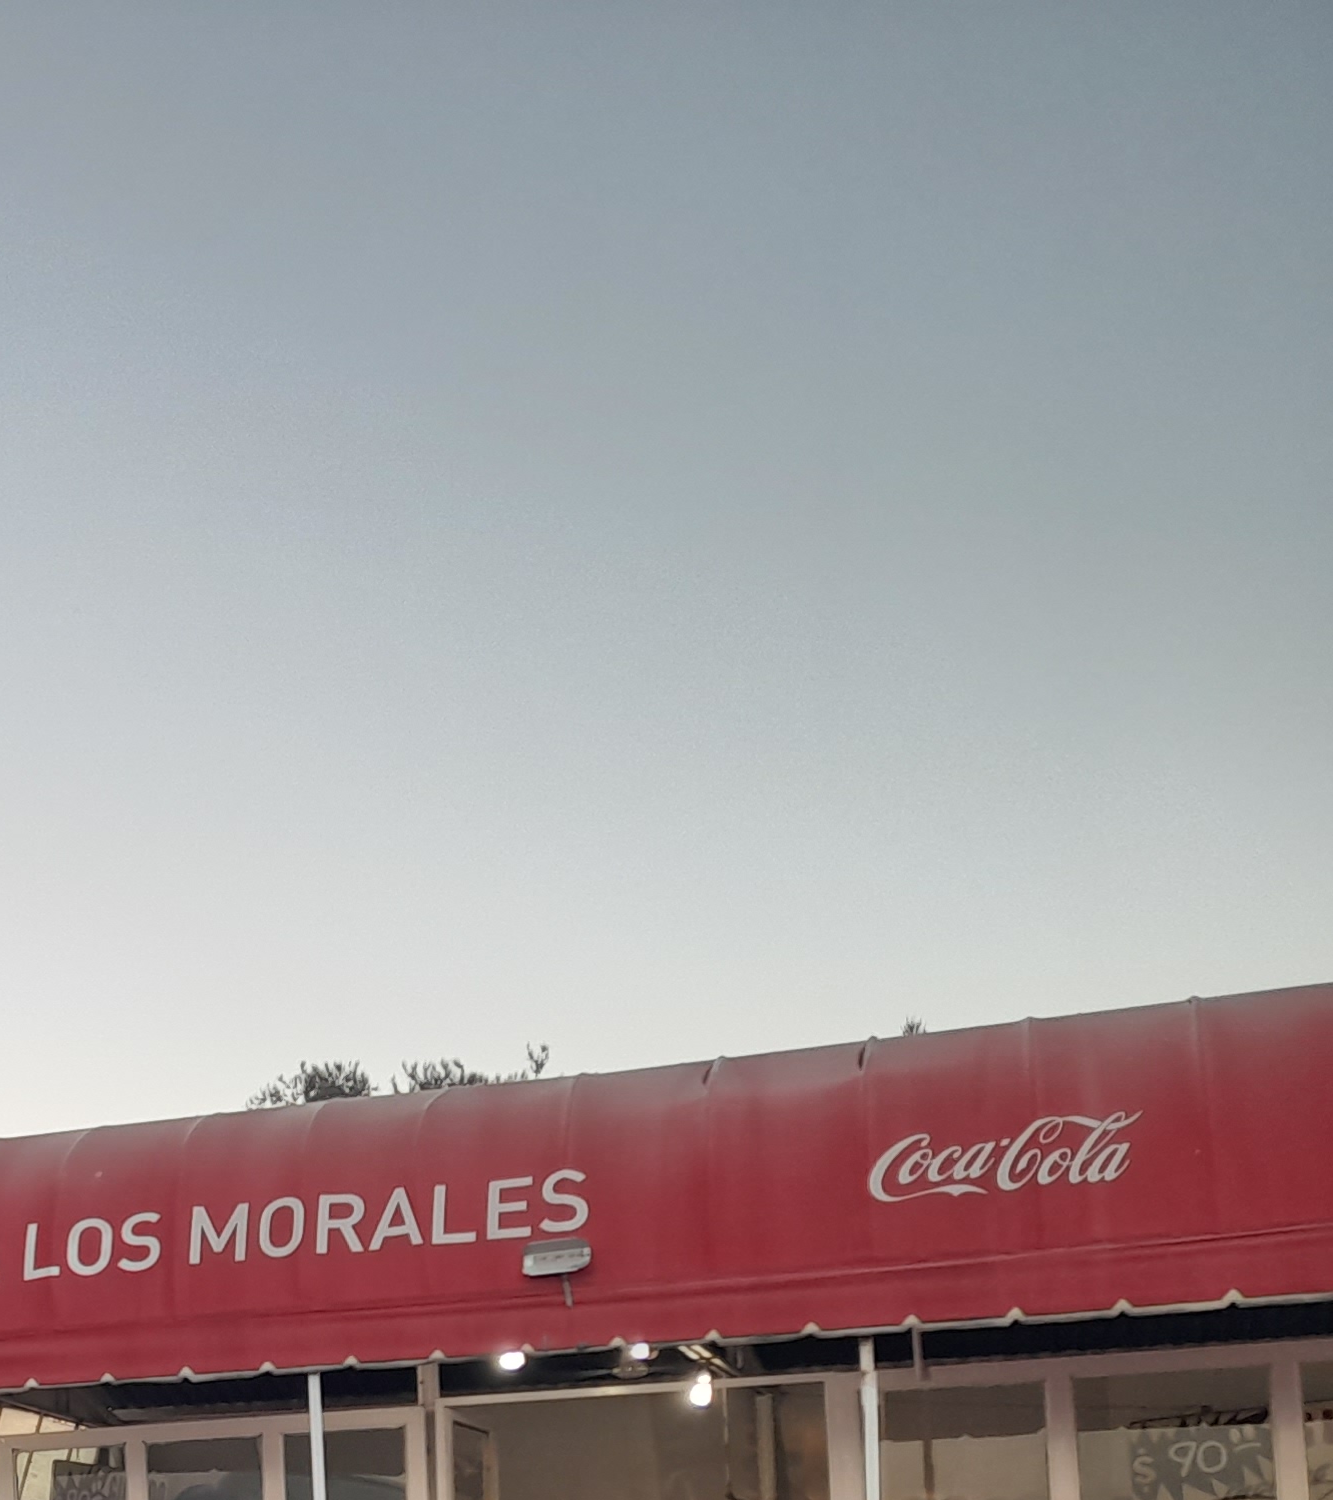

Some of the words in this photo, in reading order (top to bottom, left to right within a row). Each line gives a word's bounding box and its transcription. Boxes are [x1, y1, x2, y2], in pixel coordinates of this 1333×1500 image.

[868, 1110, 1143, 1202] Coca-Cola
[23, 1212, 162, 1282] LOS
[189, 1169, 590, 1264] MORALES
[1167, 1440, 1228, 1478] 90
